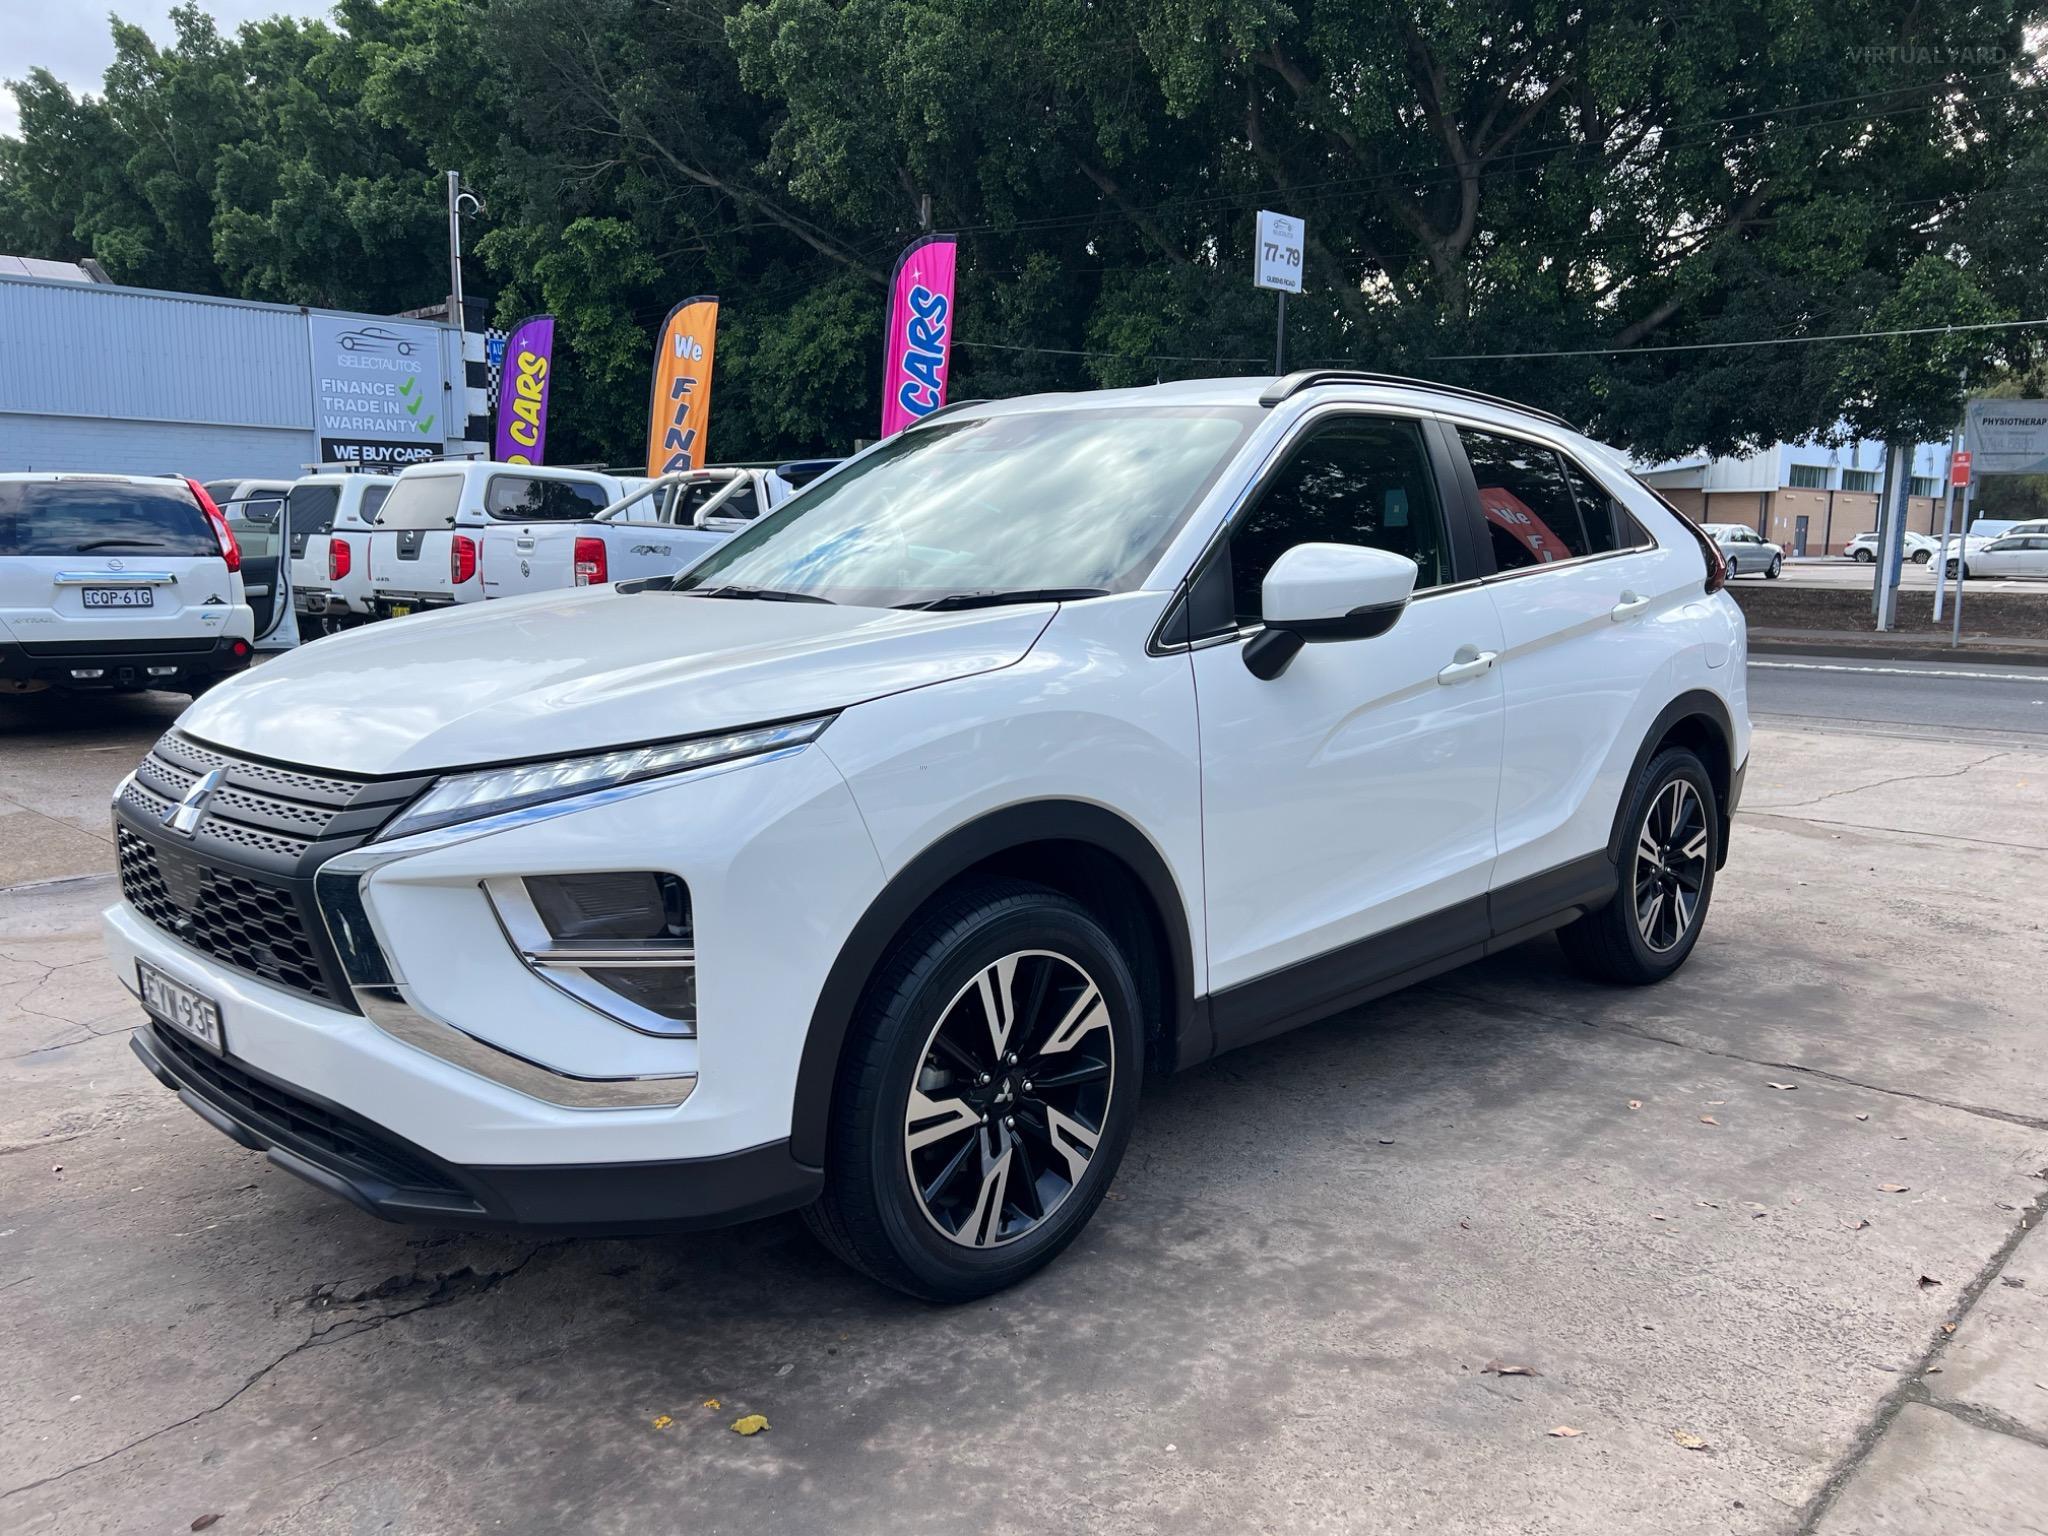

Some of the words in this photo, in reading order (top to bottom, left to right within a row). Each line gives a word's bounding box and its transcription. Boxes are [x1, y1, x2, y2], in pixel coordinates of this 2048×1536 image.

[674, 333, 704, 362] We
[899, 284, 949, 417] CARS
[321, 378, 396, 396] FINANCE
[322, 397, 380, 413] TRADE
[384, 402, 400, 415] IN
[509, 351, 549, 448] CARS
[324, 415, 418, 433] WARRANTY
[333, 445, 360, 460] WE
[362, 445, 393, 461] BUY
[393, 447, 433, 462] CARS
[1490, 507, 1531, 525] We
